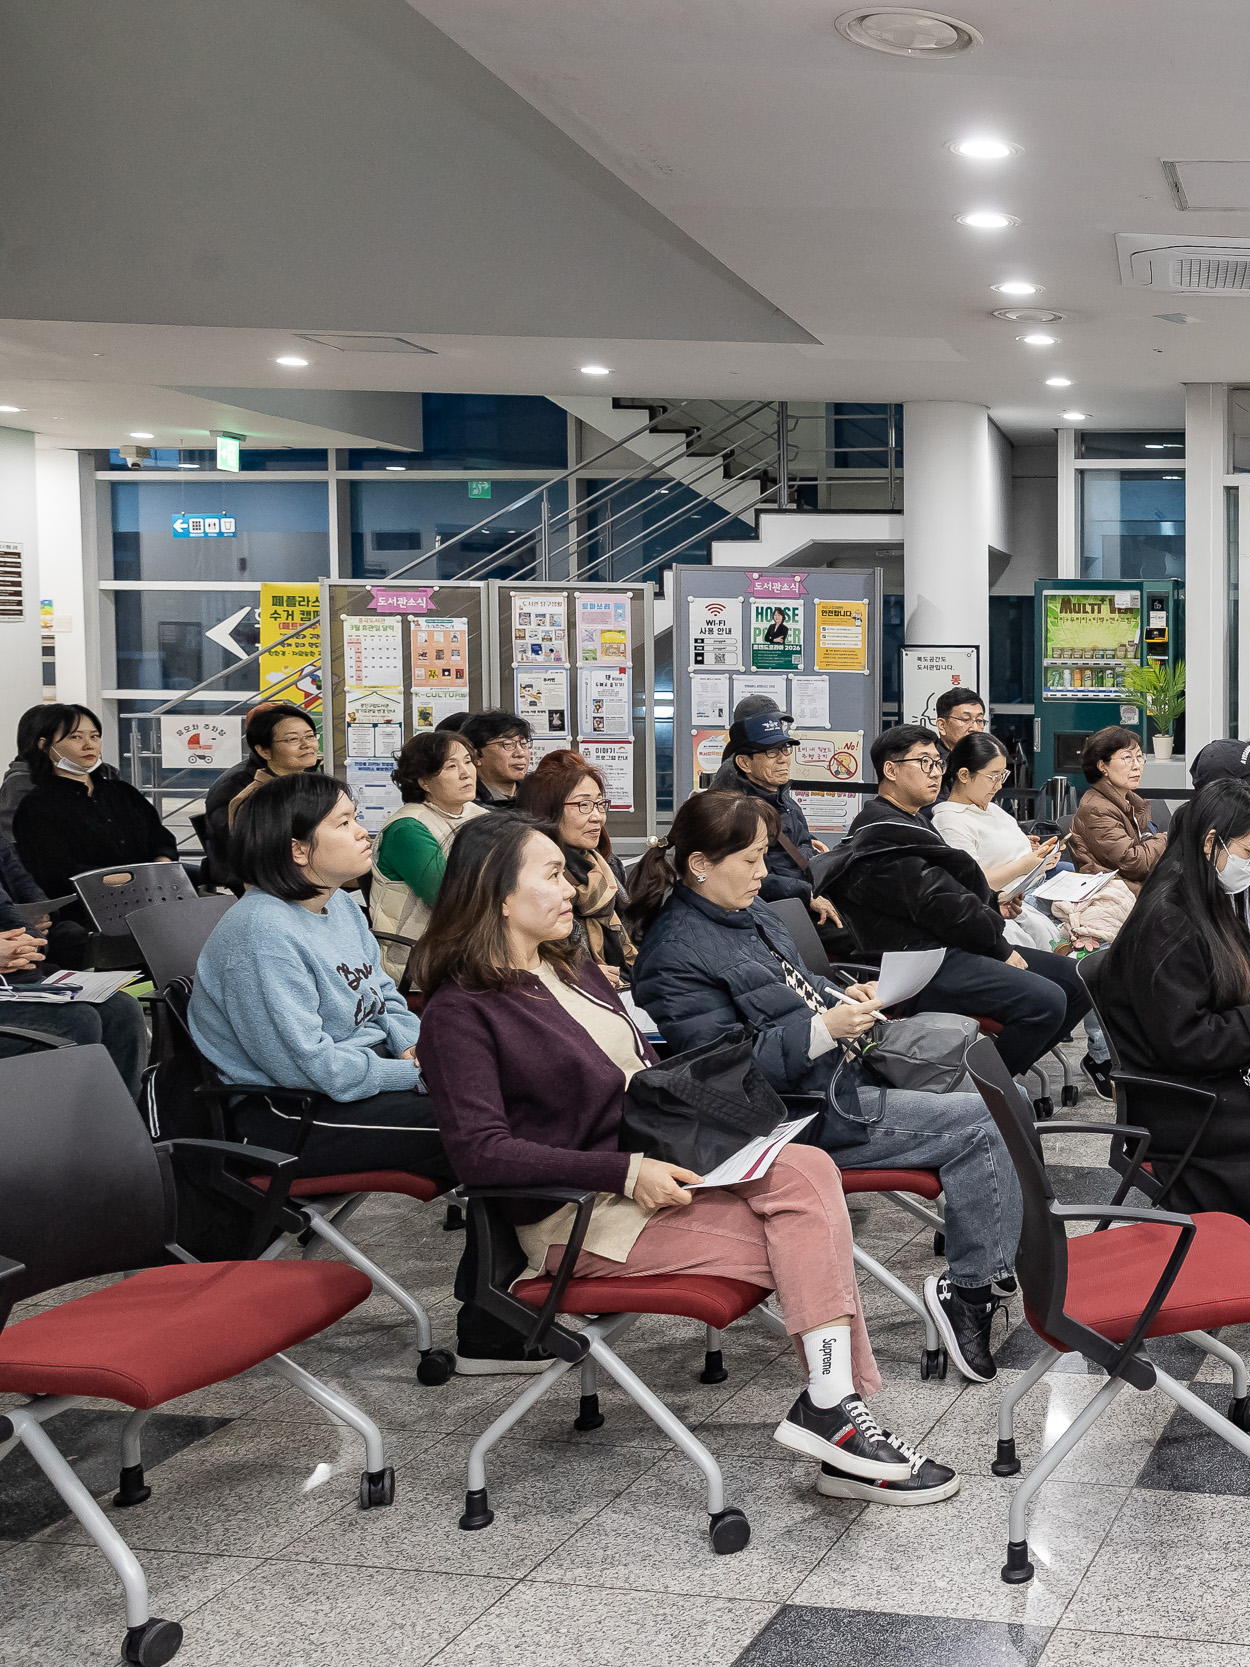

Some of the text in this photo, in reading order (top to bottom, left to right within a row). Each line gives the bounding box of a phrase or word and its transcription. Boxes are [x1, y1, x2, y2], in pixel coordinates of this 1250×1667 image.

[753, 582, 799, 593] 도서관소식
[377, 597, 427, 608] 도서관소식
[269, 609, 294, 621] 수거
[755, 606, 799, 623] HOSE
[821, 609, 852, 617] 안전합니다
[699, 627, 732, 635] 사용 안내
[951, 674, 961, 685] 통
[176, 723, 227, 737] 유모차 주차장
[843, 741, 860, 751] No!
[818, 1337, 837, 1375] Supreme
